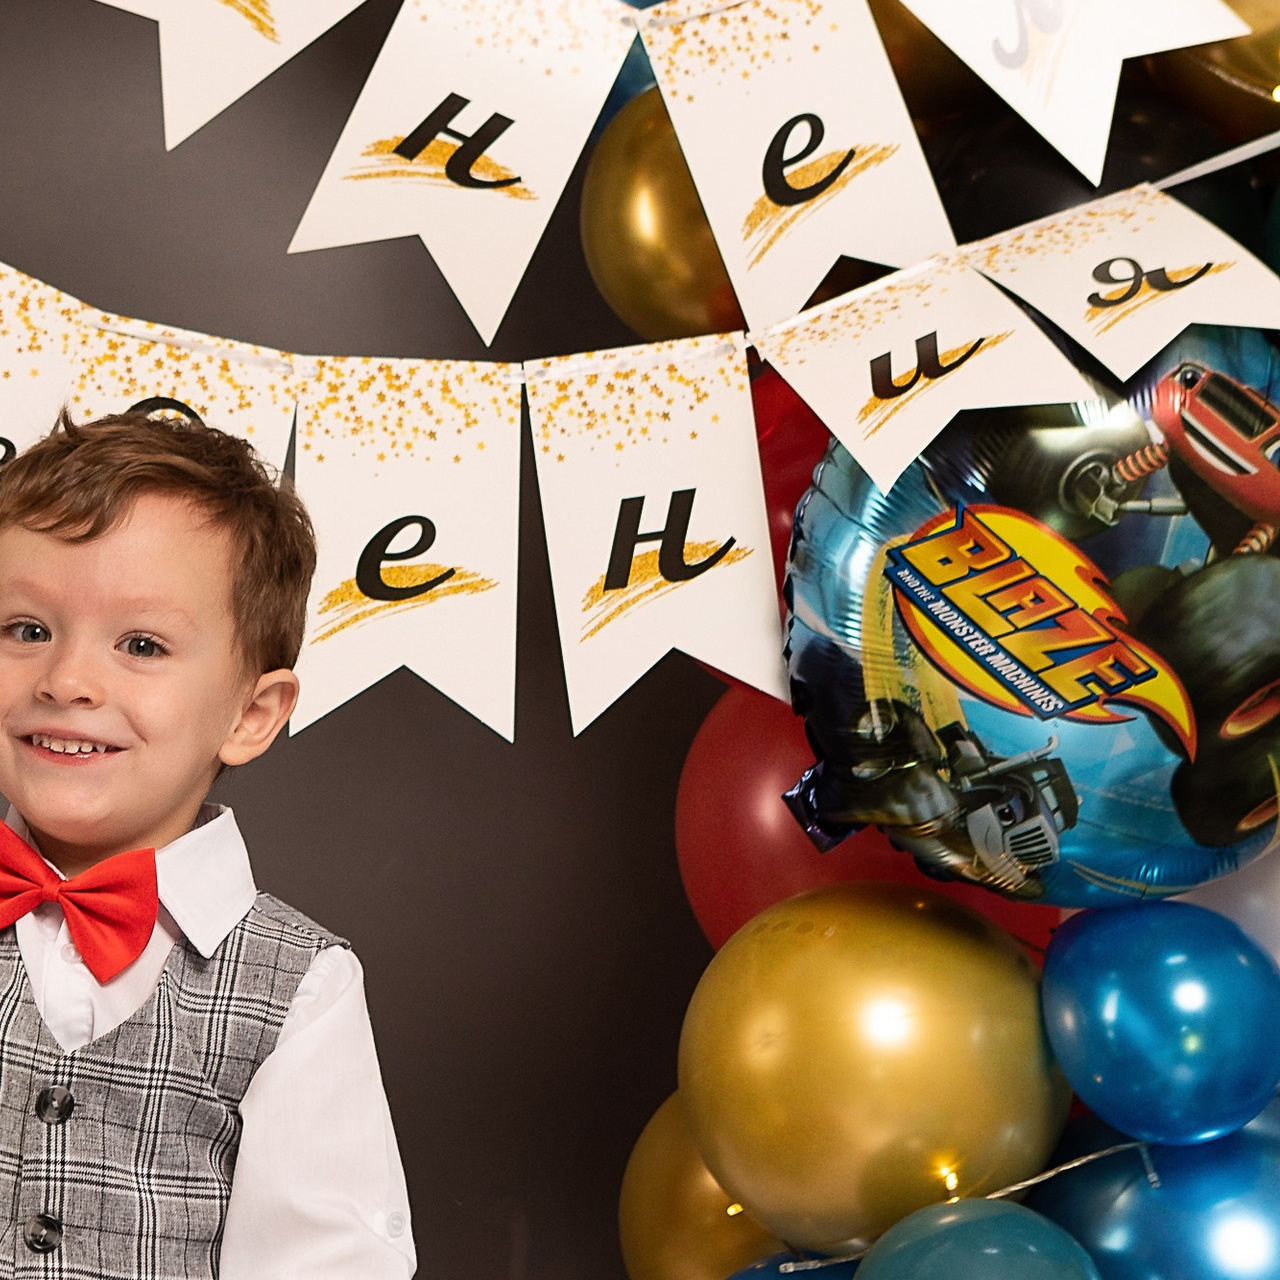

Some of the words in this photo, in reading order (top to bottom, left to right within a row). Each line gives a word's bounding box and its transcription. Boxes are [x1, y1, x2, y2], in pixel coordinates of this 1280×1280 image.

[898, 506, 1154, 705] BLAZE
[927, 599, 998, 660] MONSTER
[986, 651, 1064, 712] MACHINES
